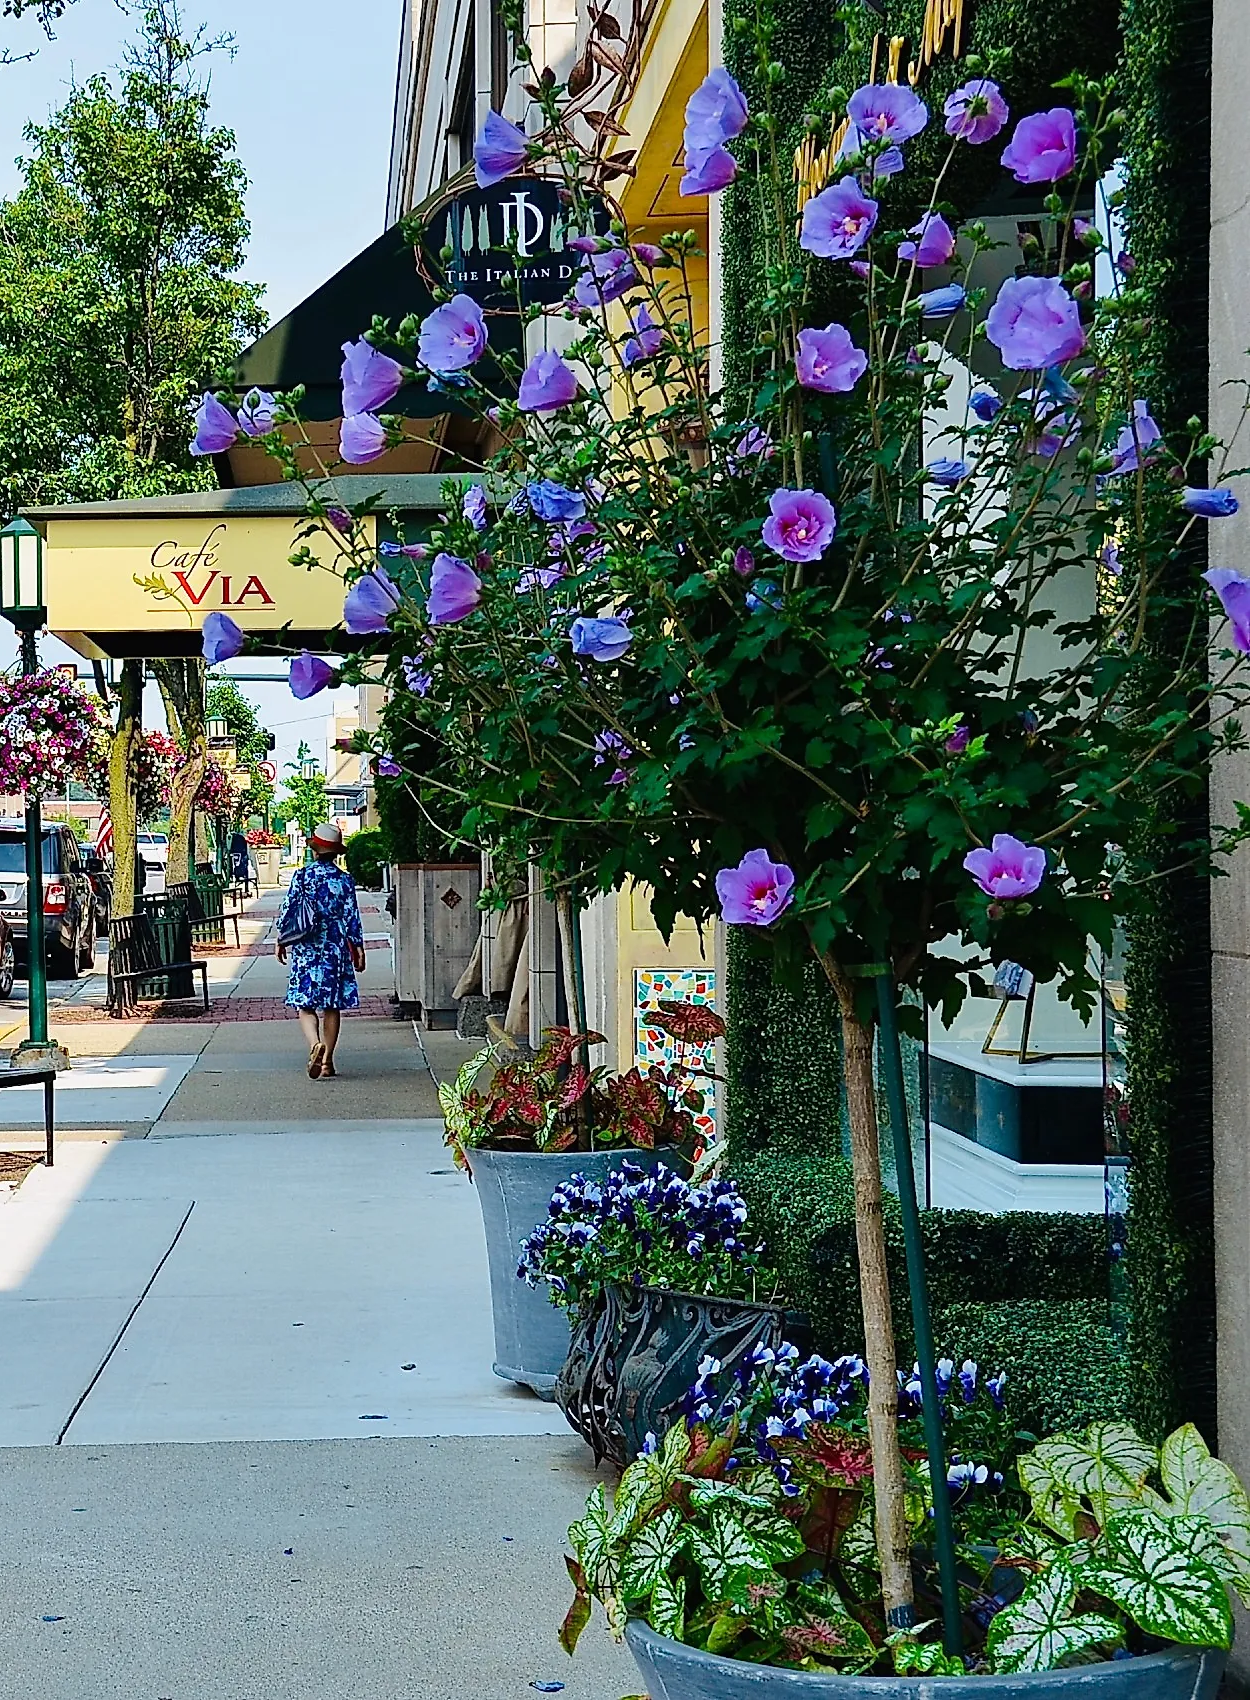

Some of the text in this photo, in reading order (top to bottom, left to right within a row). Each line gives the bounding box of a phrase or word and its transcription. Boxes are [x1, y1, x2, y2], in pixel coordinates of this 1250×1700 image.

[485, 267, 551, 282] ITALIAN
[150, 523, 227, 580] Café
[170, 570, 276, 605] VIA
